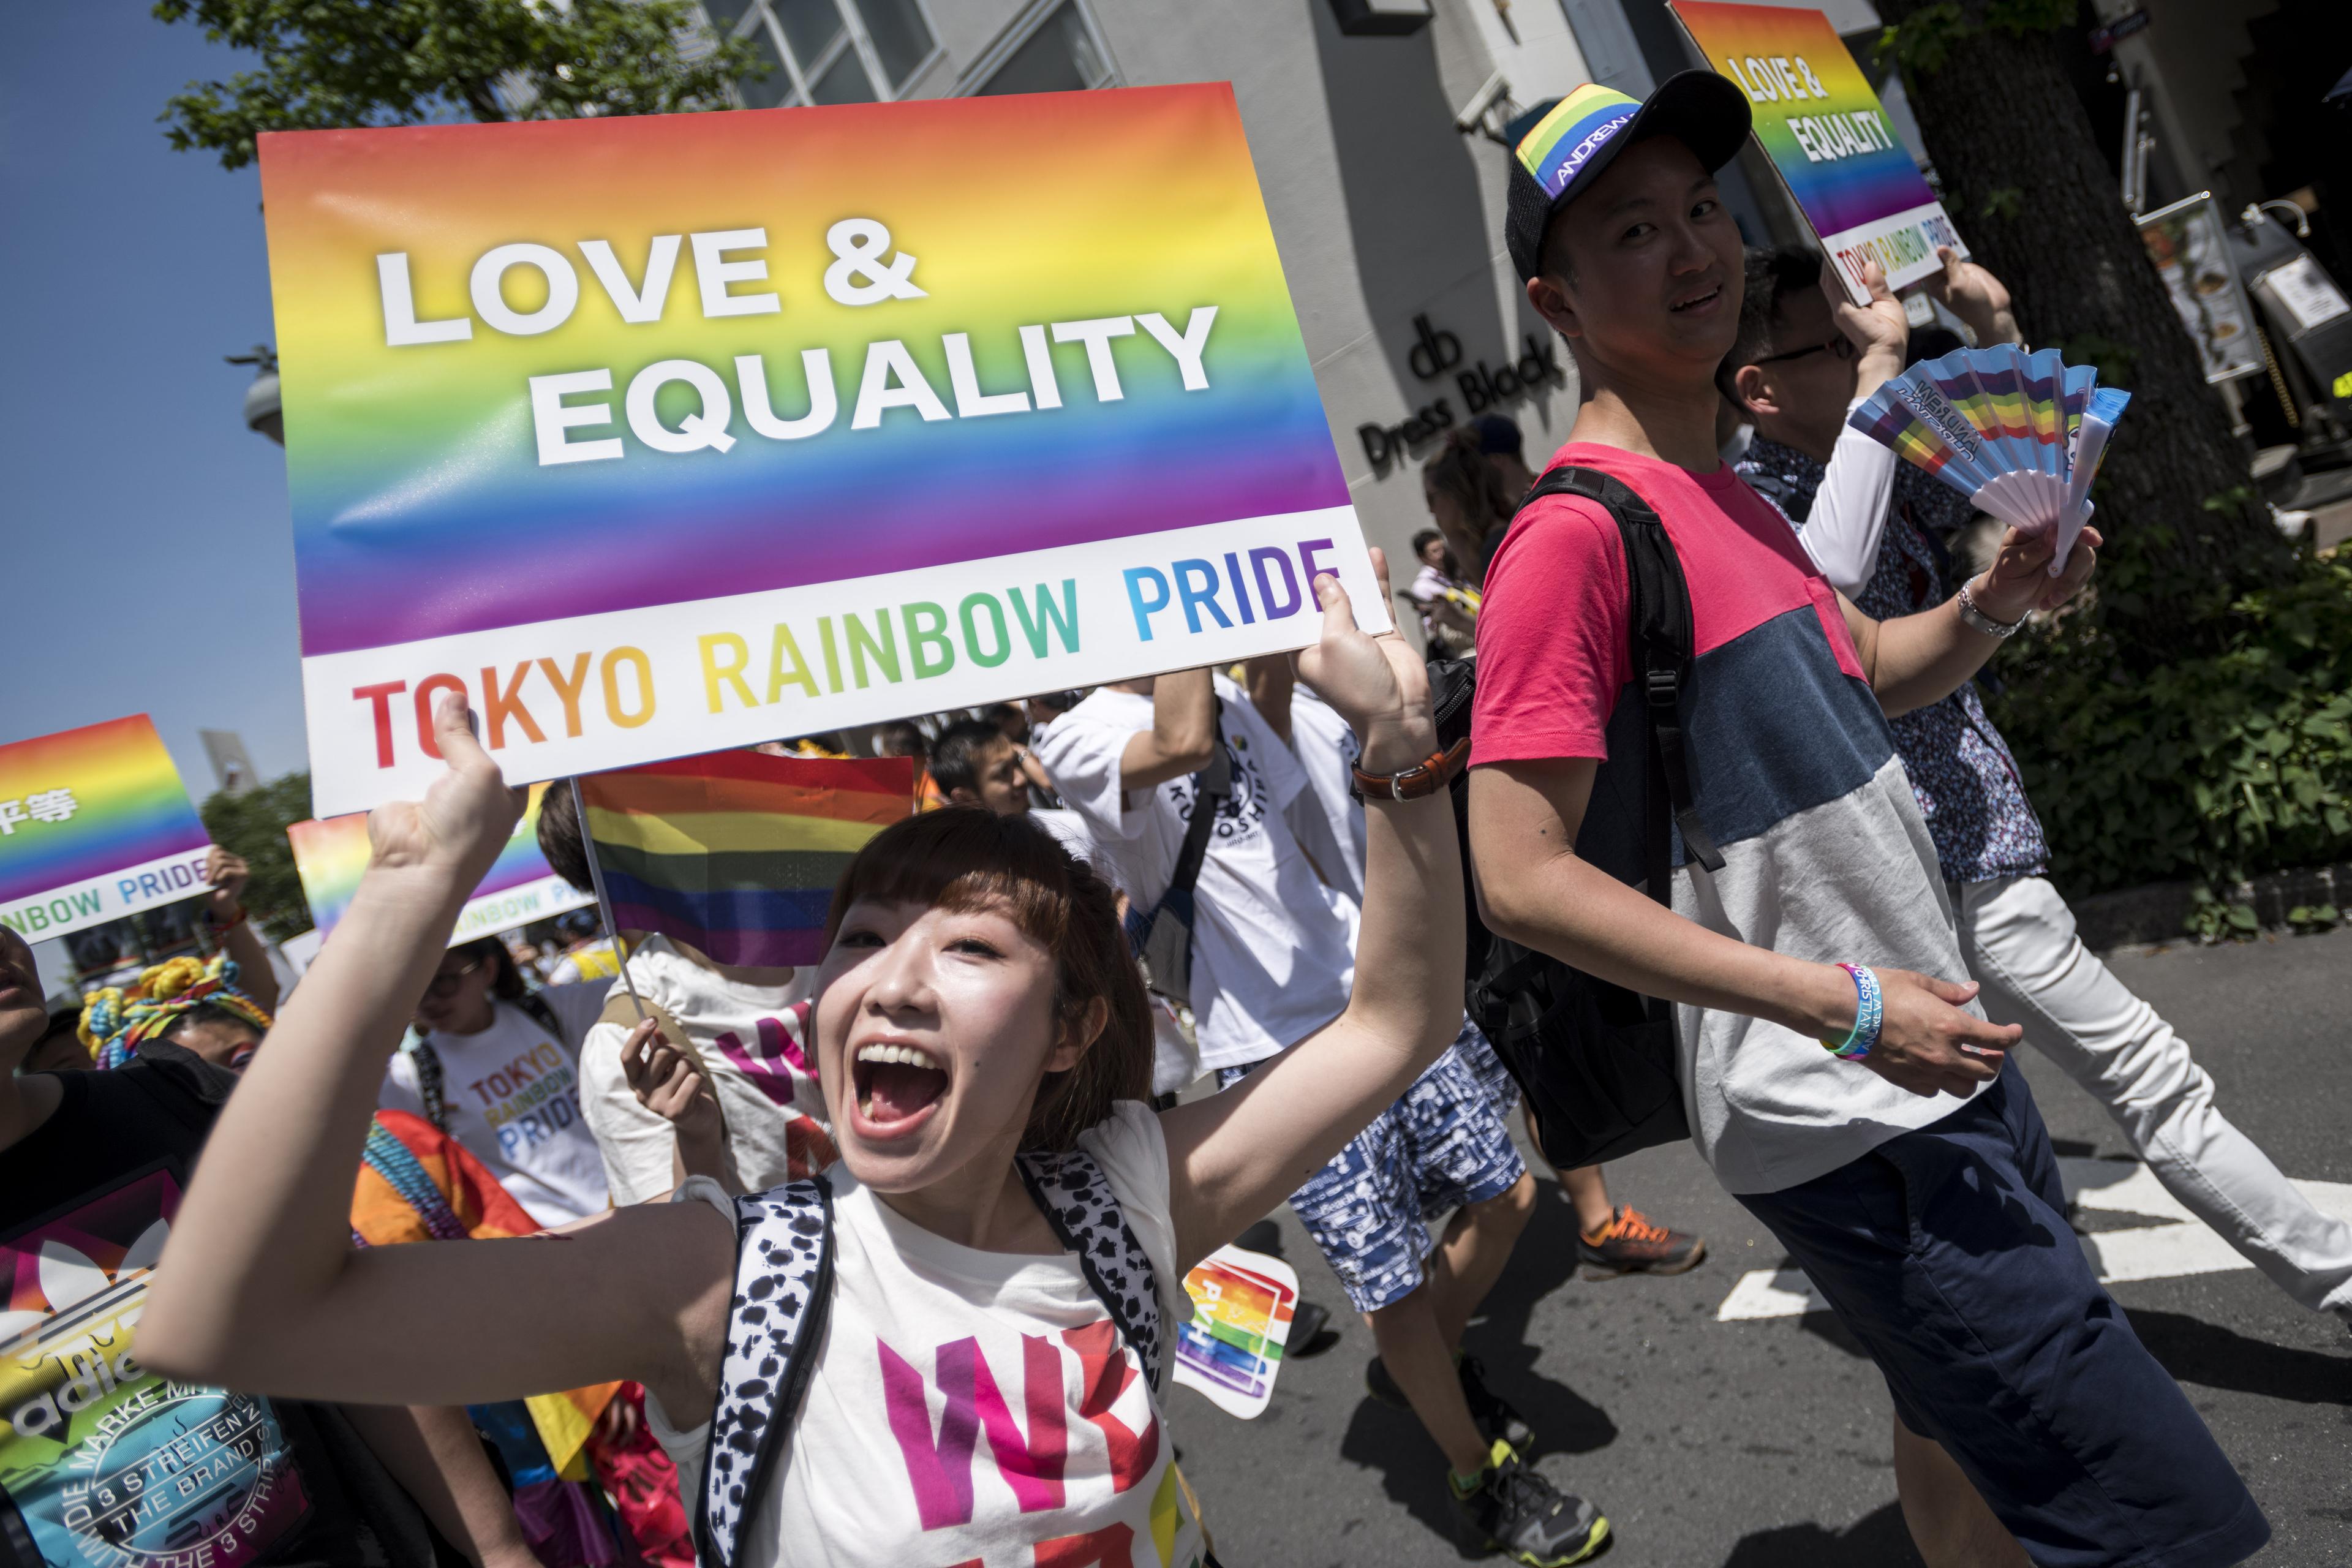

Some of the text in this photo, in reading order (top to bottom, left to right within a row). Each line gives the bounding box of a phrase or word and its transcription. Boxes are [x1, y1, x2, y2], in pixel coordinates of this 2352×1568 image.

[1727, 56, 1830, 102] LOVE &
[1557, 116, 1629, 187] ANDREW
[1786, 110, 1893, 163] EQUALITY
[376, 217, 930, 347] LOVE &
[529, 305, 1219, 467] EQUALITY
[1356, 331, 1567, 477] Dress Black
[351, 537, 1341, 770] TOKYO RAINBOW PRIDE
[0, 788, 78, 835] 平等
[1169, 759, 1267, 839] KUOSHIBA
[117, 859, 209, 905] PRIDE
[1855, 970, 1873, 1033] CHRISTIAN
[468, 1042, 562, 1107] TOKYO
[484, 1066, 571, 1132] RAINBOW
[1187, 1278, 1224, 1349] PVH
[69, 1386, 159, 1470] MARKE
[98, 1412, 242, 1508] 3 STREIFEN
[62, 1477, 93, 1528] DIE
[111, 1438, 254, 1533] THE BRAND
[221, 1532, 238, 1555] 3
[238, 1425, 275, 1534] STRIPES
